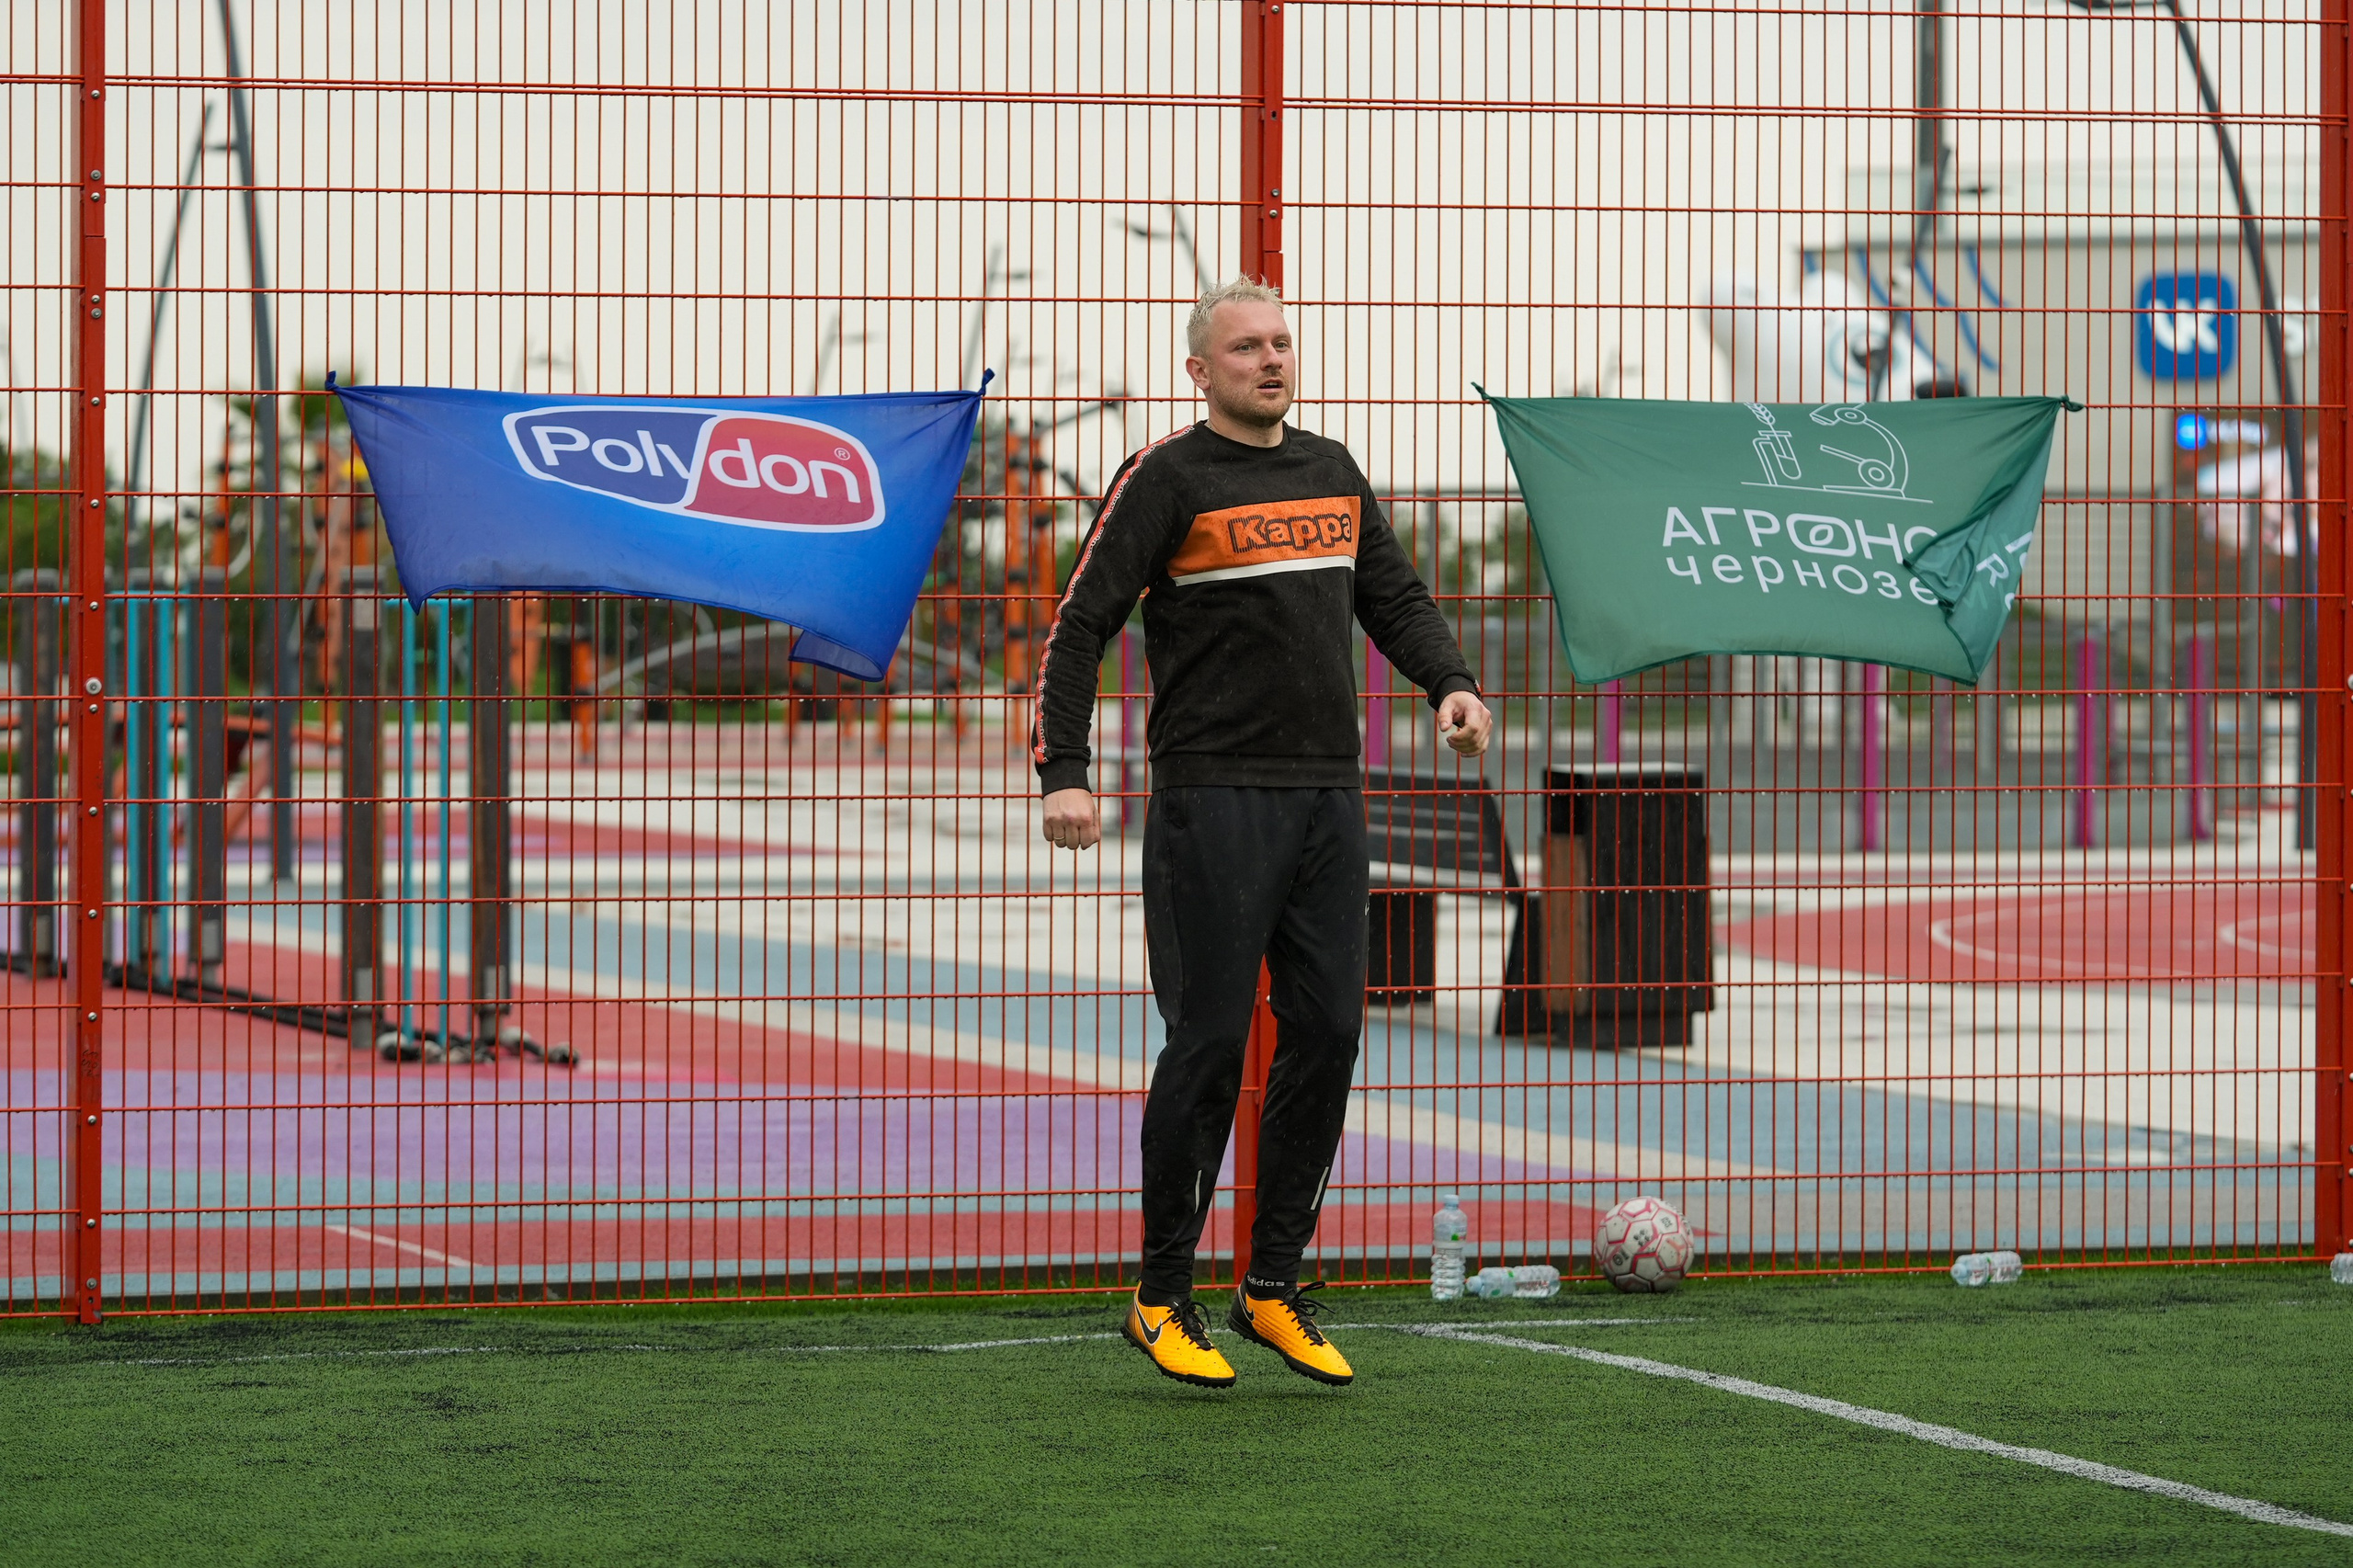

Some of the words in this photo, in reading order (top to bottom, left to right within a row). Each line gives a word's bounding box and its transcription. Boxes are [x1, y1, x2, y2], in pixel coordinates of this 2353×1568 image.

[530, 425, 862, 505] Polydon
[1228, 513, 1352, 553] Kappa
[1247, 1275, 1285, 1287] adidas
